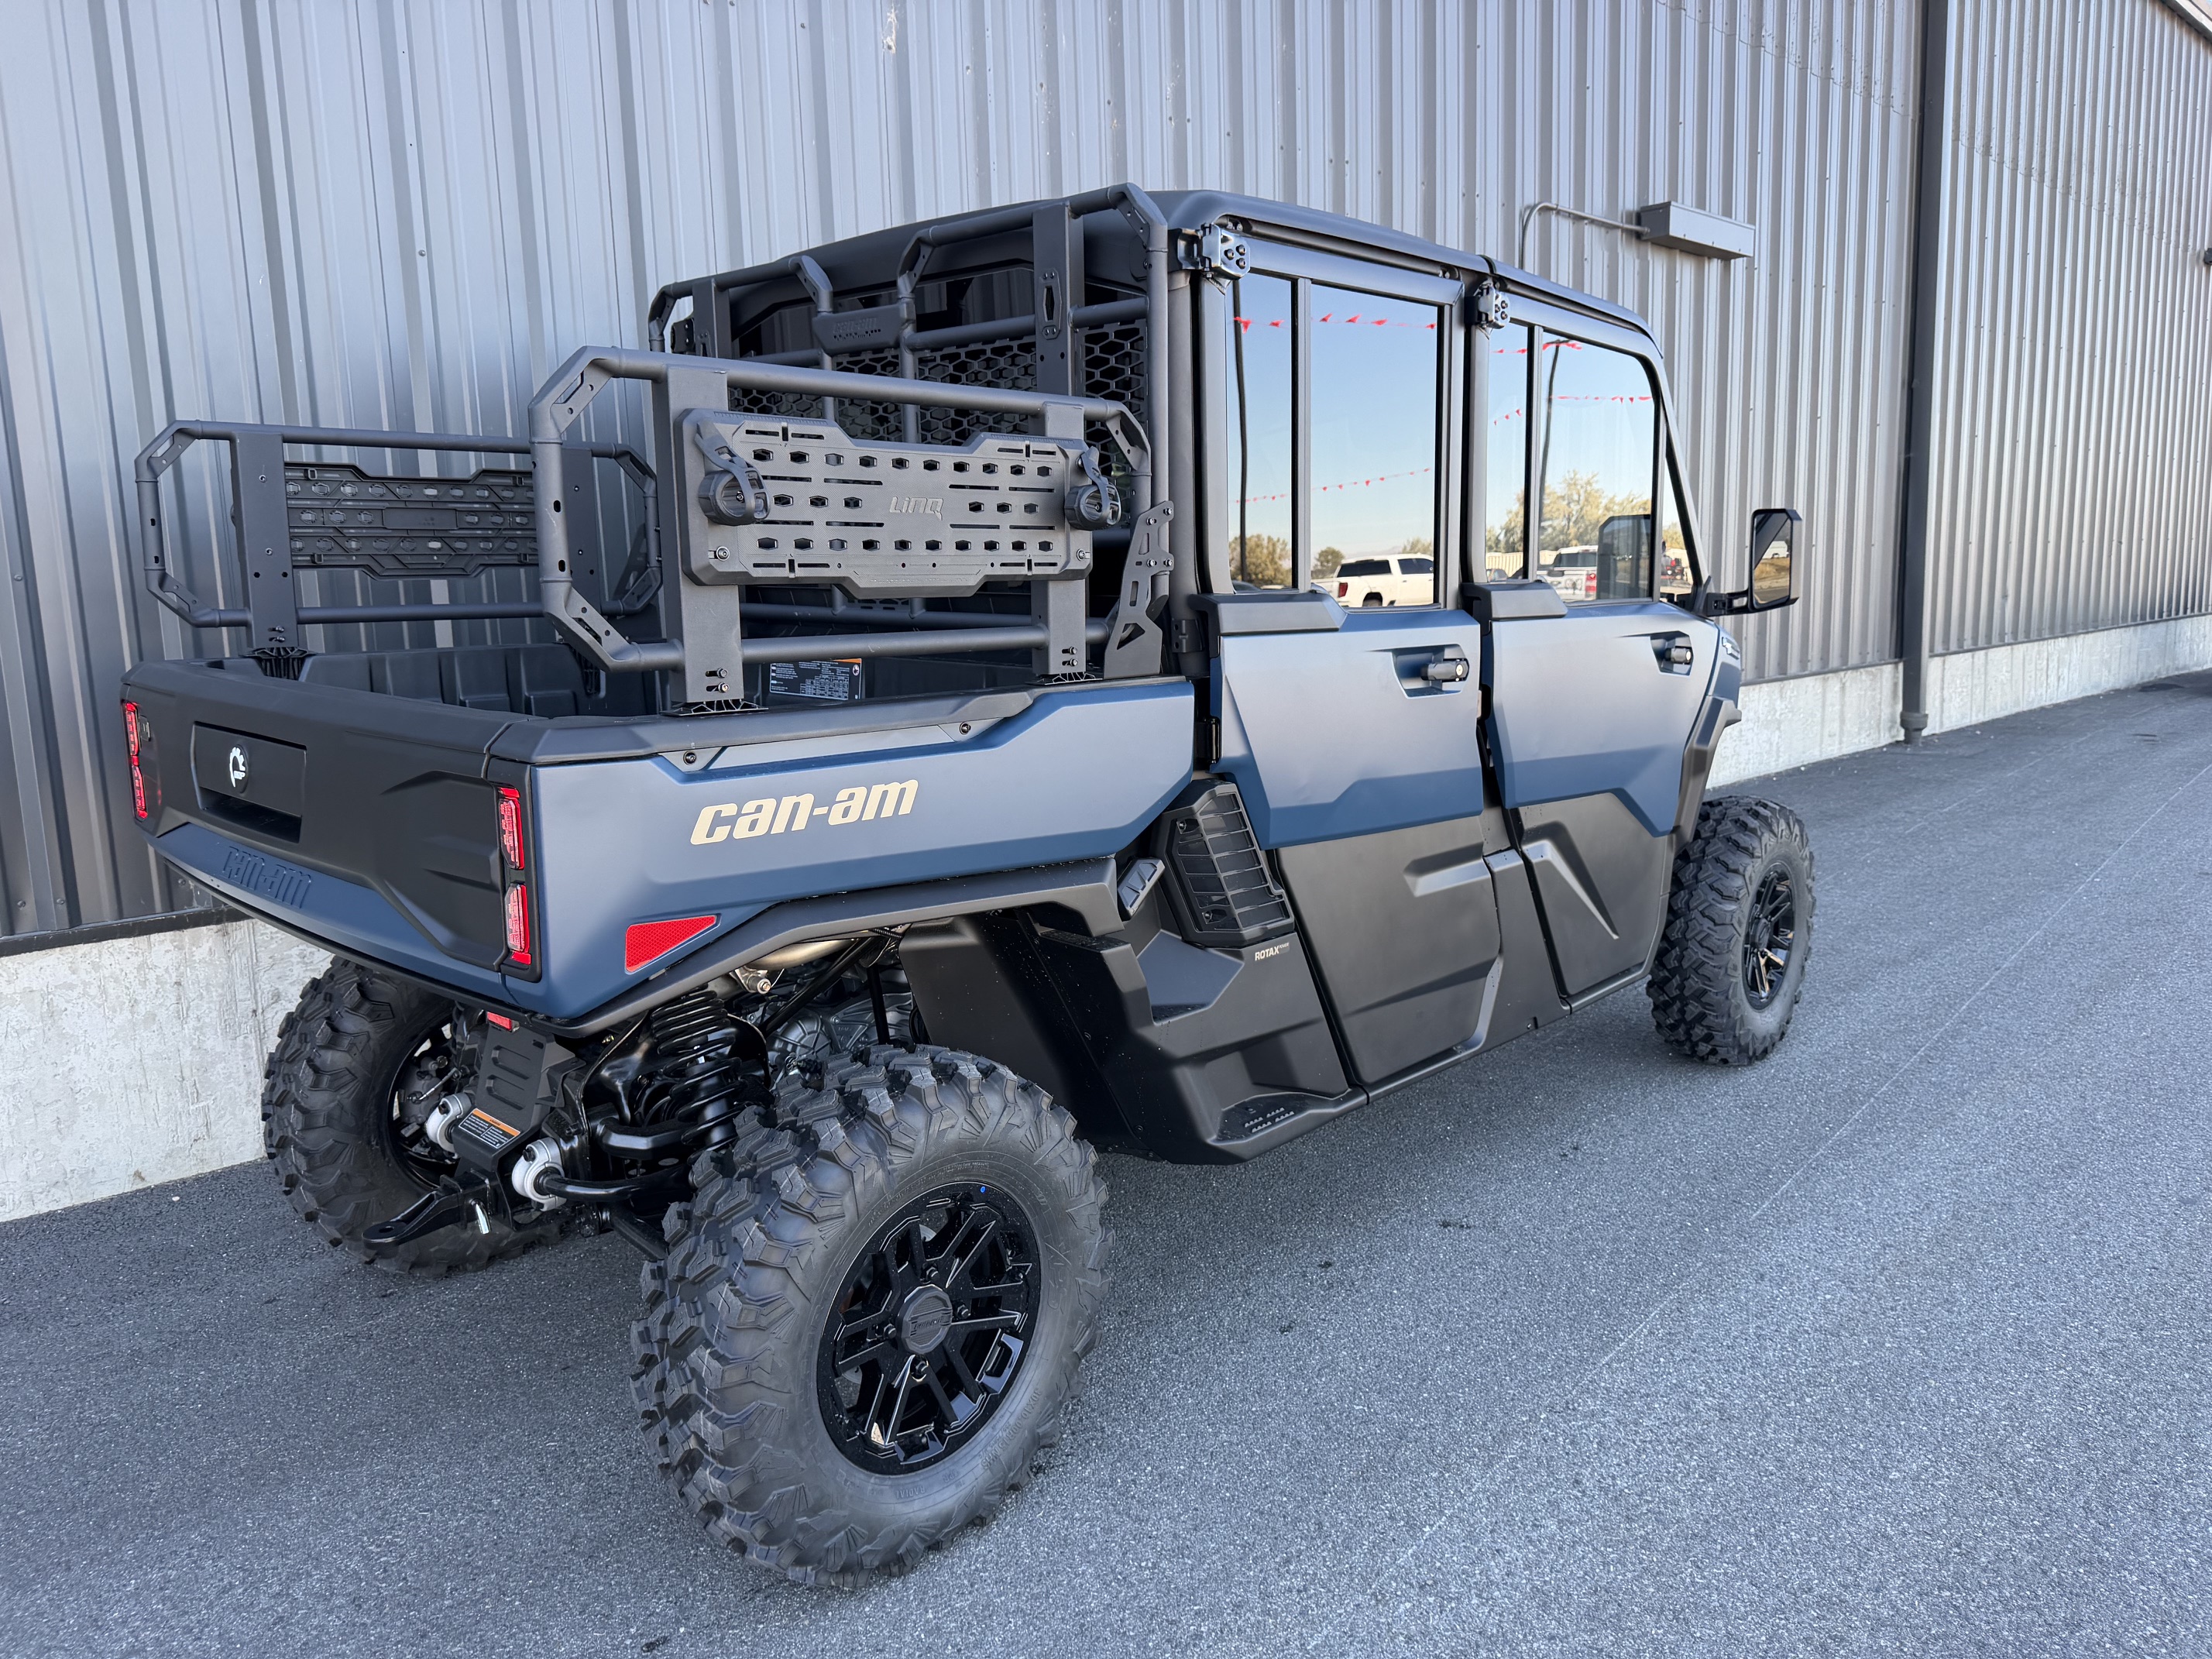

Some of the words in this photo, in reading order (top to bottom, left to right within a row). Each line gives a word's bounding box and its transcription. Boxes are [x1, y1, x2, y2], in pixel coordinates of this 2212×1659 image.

[689, 779, 919, 846] can-am
[1255, 945, 1279, 961] ROTAX
[896, 1486, 926, 1499] RADIAL
